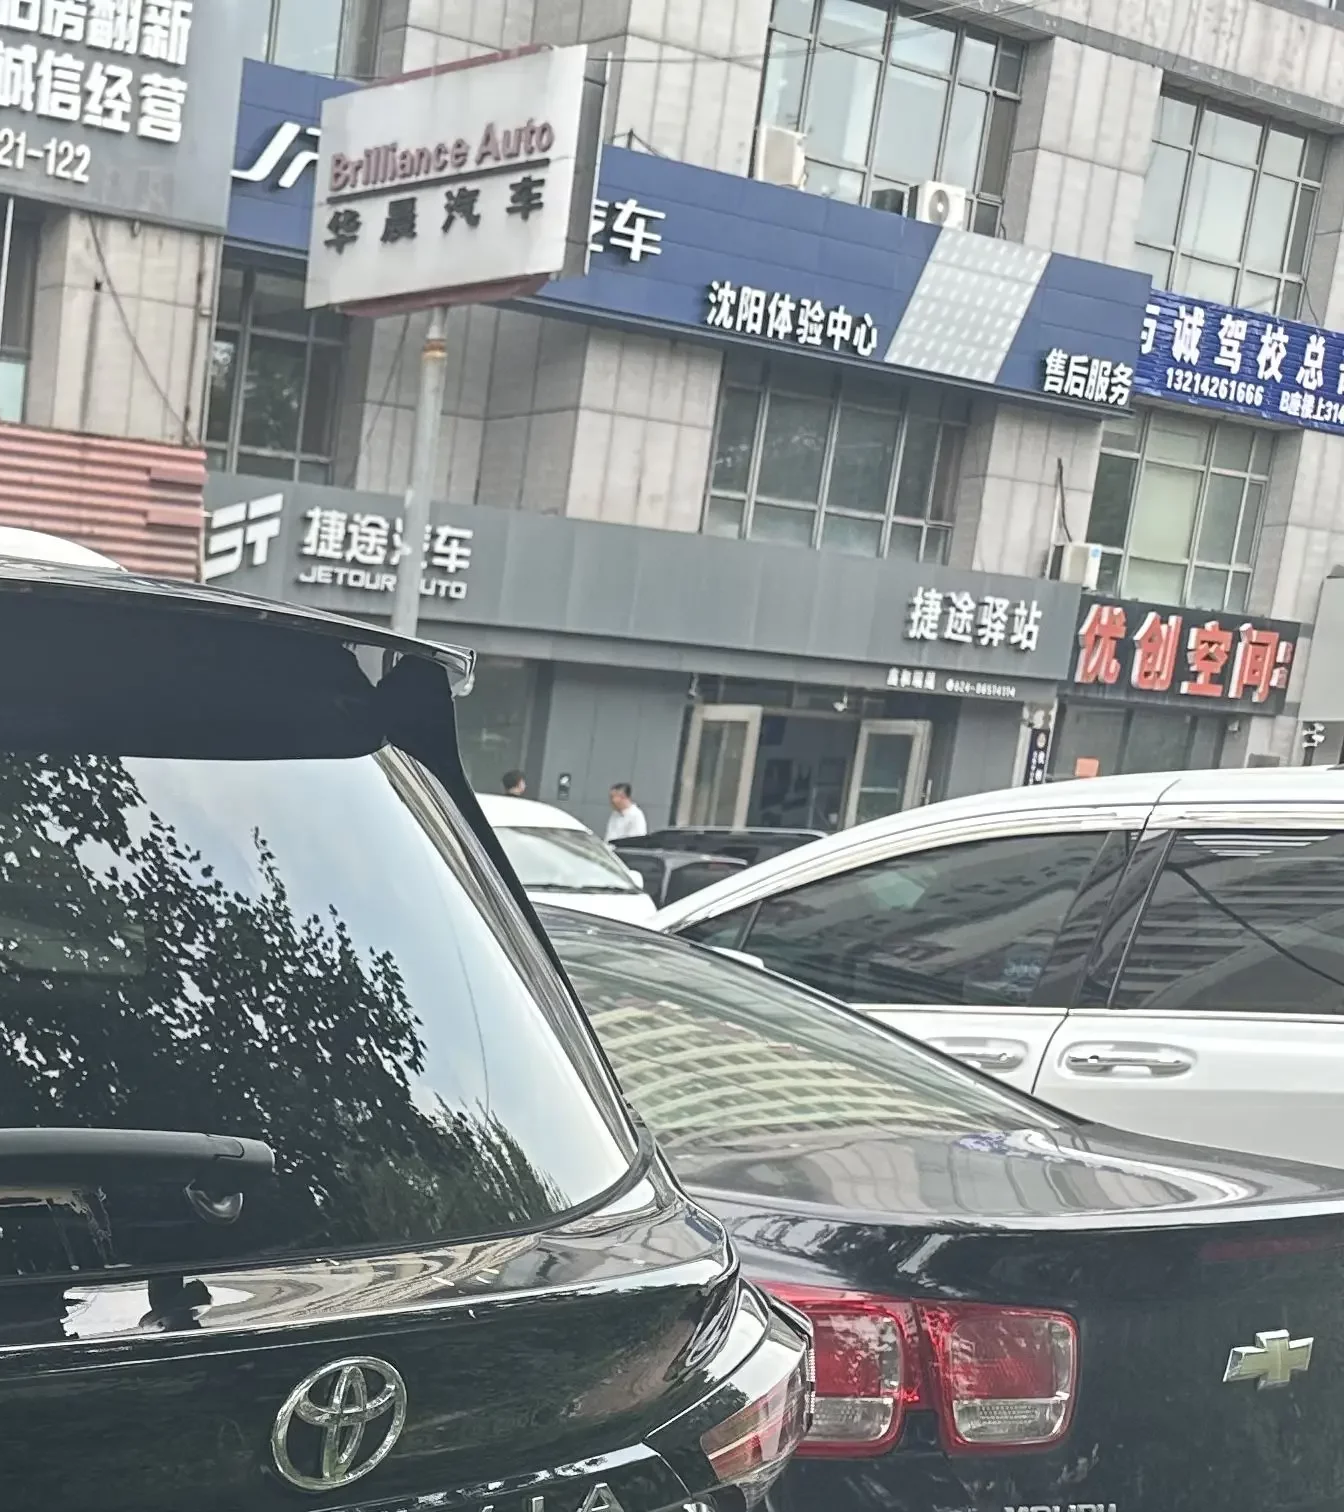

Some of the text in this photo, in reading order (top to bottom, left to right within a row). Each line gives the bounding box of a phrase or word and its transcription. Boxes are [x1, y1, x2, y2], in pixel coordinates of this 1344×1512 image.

[329, 138, 472, 193] Brilliance
[474, 118, 556, 167] Auto
[323, 175, 547, 256] 华晨汽车
[705, 279, 878, 357] 沈阳体验中心
[1043, 347, 1133, 406] 售后服务
[298, 564, 468, 600] JETOUR UTO
[908, 586, 1043, 651] 捷途驿站
[1074, 603, 1280, 703] 优创空间
